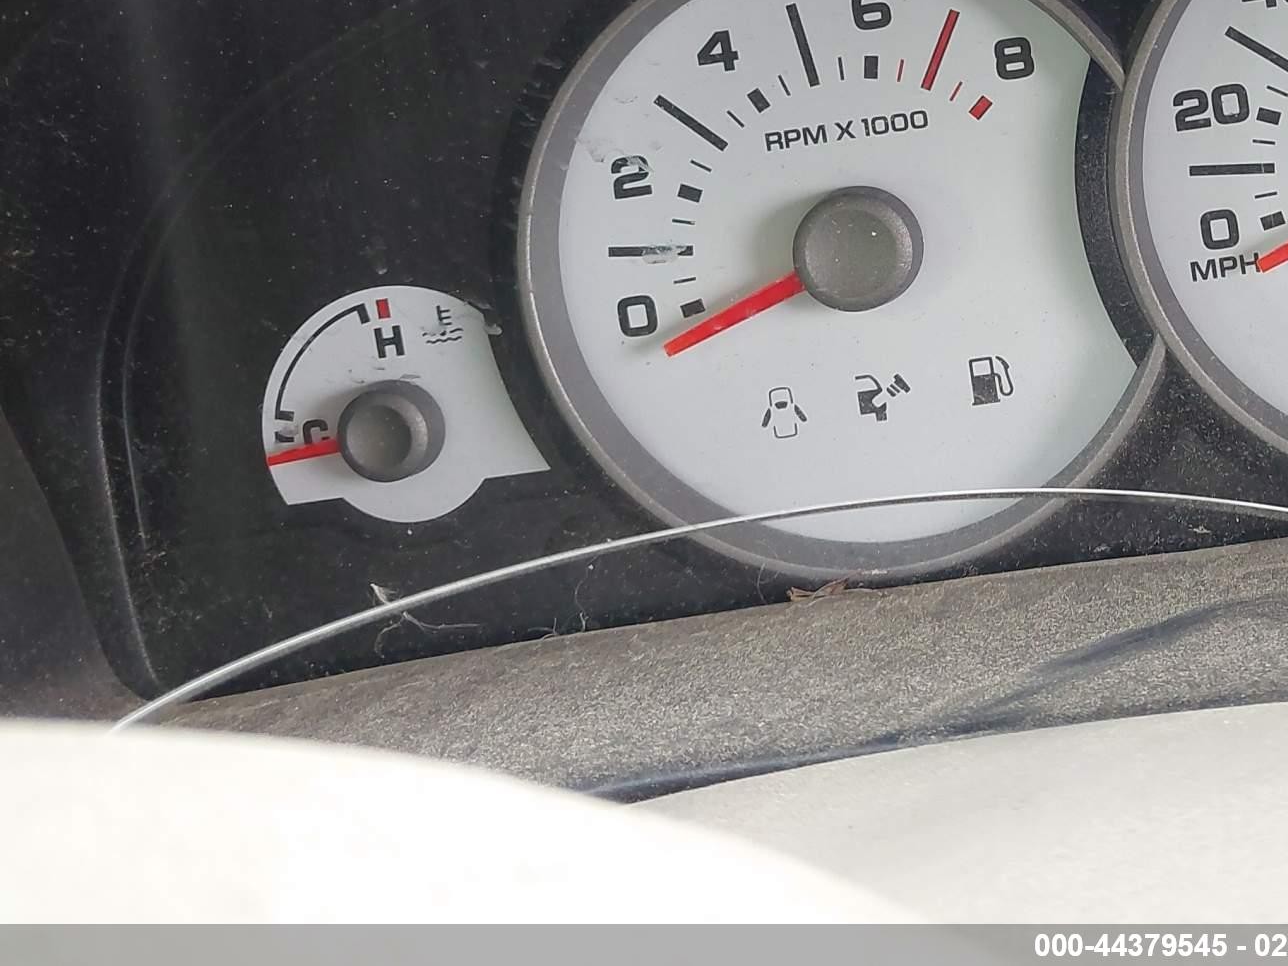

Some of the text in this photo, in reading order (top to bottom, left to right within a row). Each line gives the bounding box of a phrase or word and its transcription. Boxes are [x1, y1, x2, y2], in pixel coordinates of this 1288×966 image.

[697, 30, 739, 71] 4
[993, 37, 1035, 80] 8
[1172, 83, 1250, 132] 20
[764, 109, 929, 152] RPM X 1000
[610, 155, 653, 199] 2
[1200, 209, 1239, 251] 0
[1190, 251, 1261, 283] MPH
[617, 295, 658, 337] 0
[373, 325, 405, 359] H
